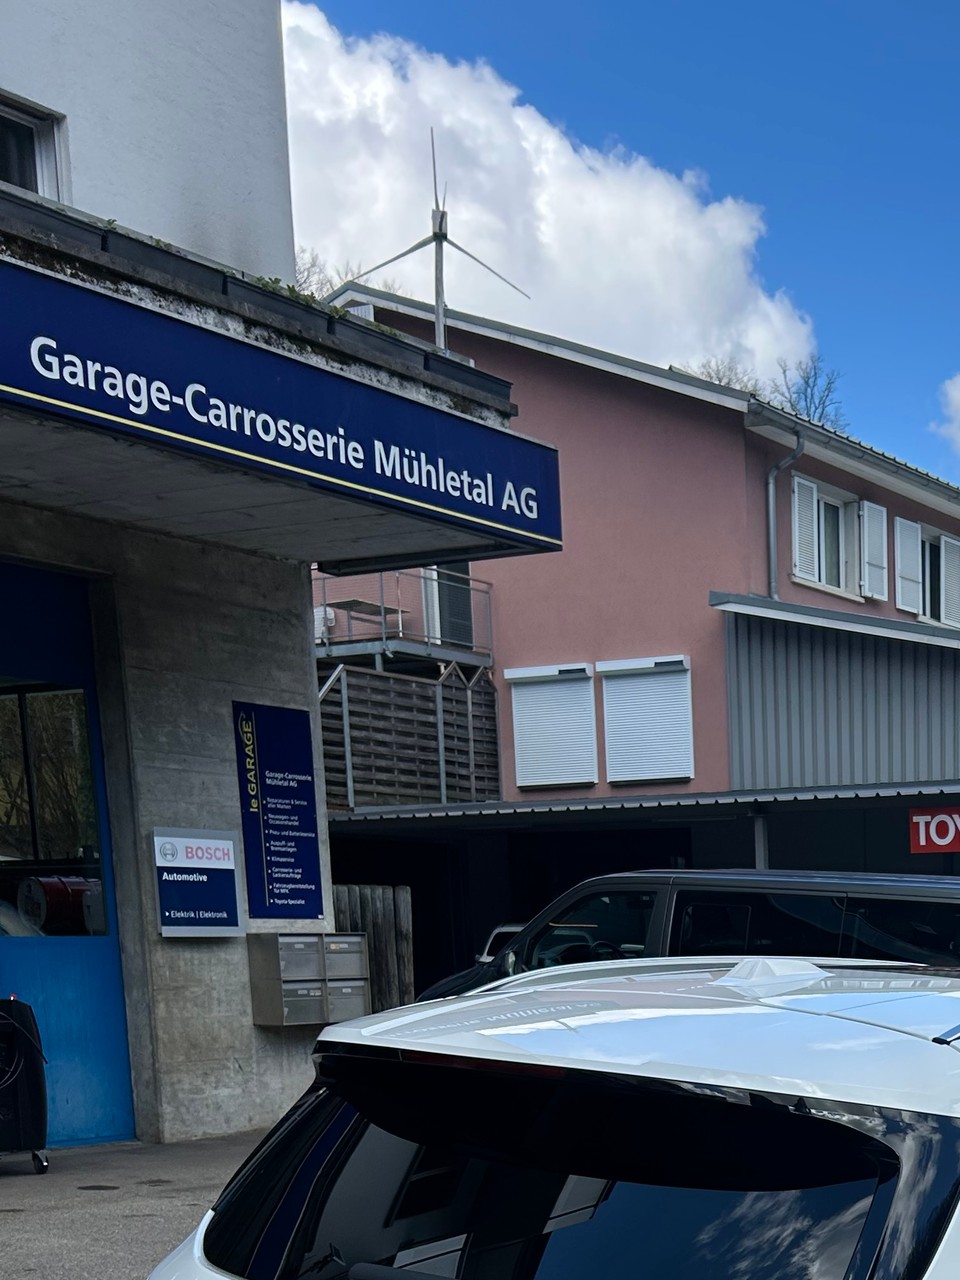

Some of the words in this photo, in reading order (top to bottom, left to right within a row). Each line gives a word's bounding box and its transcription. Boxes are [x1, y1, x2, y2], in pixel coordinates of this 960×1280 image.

[30, 336, 365, 471] Garage-Carrosserie
[374, 440, 494, 508] Mühletal
[501, 481, 539, 520] AG
[242, 720, 257, 796] GARAGE
[289, 780, 298, 788] AG
[185, 845, 231, 861] BOSCH
[162, 871, 208, 882] Automotive
[170, 910, 195, 918] Elektrik
[199, 910, 228, 919] Elektronik
